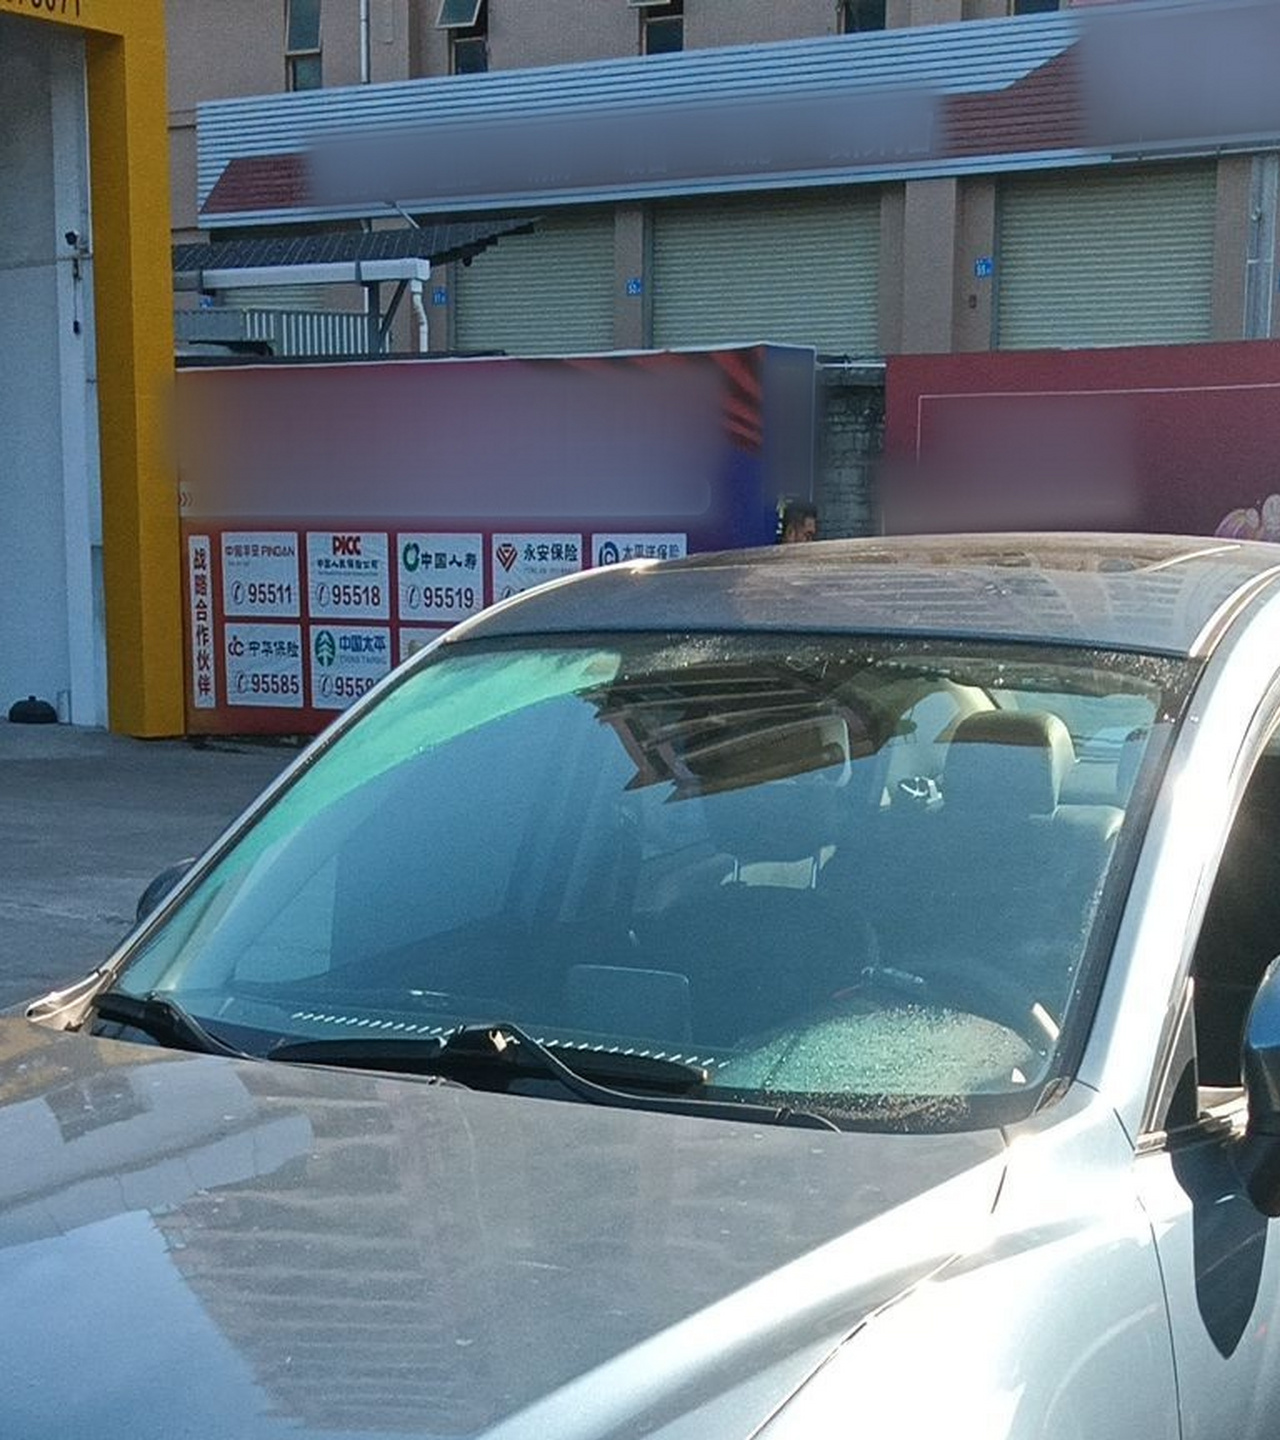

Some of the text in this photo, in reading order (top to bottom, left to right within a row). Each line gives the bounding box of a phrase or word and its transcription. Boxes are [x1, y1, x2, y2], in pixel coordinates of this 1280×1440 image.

[421, 552, 478, 571] 中国人寿
[523, 543, 578, 563] 永安保险
[248, 583, 292, 605] 95511
[332, 584, 381, 607] 95518
[423, 586, 475, 608] 95519
[193, 547, 213, 697] 战略合作伙伴
[249, 640, 300, 658] 中华保险
[338, 634, 387, 652] 中国太平
[251, 674, 300, 694] 95585
